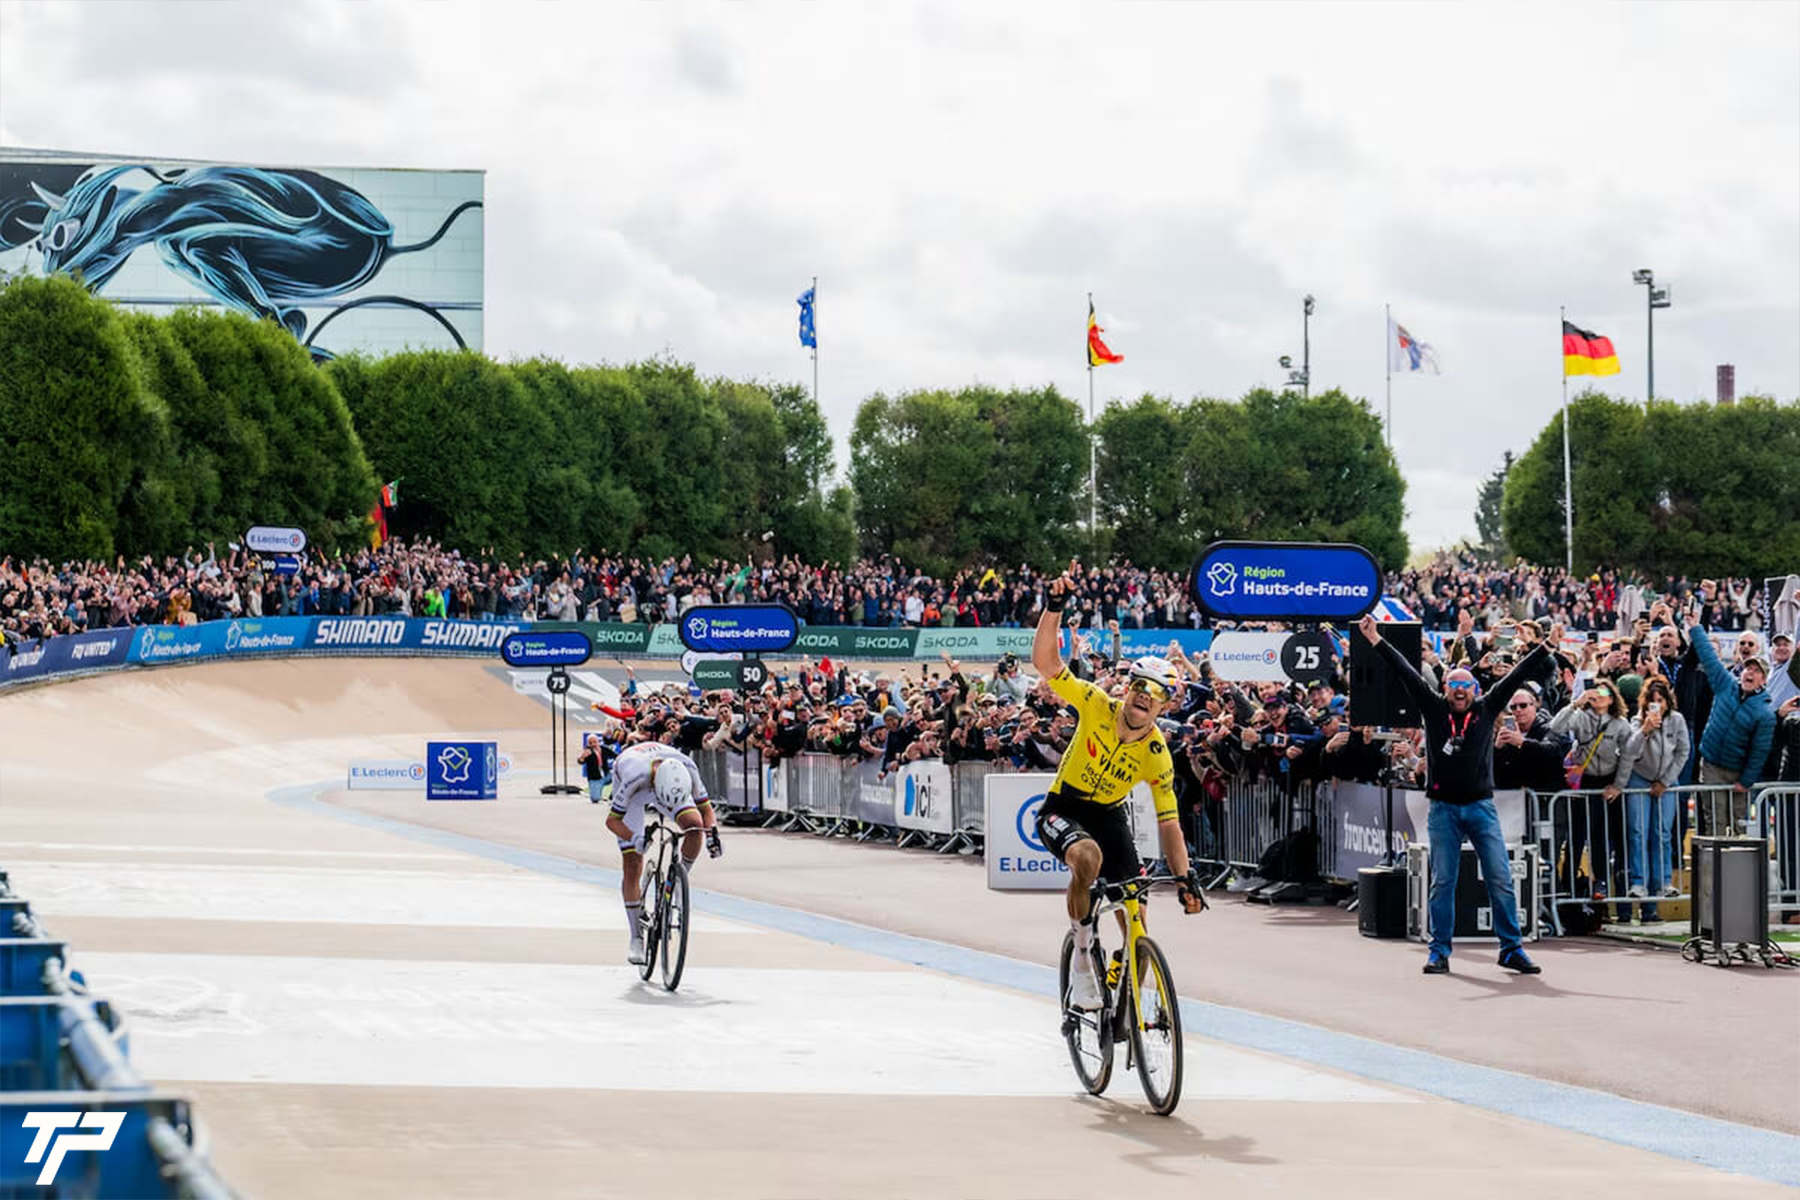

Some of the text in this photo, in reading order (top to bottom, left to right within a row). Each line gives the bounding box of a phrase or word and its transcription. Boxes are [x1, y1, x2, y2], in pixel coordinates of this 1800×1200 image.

[1243, 566, 1285, 579] Région
[1243, 582, 1369, 597] Hauts-de-France
[711, 620, 738, 628] Région
[314, 620, 405, 644] SHIMANO
[711, 628, 790, 639] Hauts-de-France
[525, 648, 586, 656] Hauts-de-France
[1294, 645, 1320, 670] 25
[743, 667, 761, 682] 50
[552, 678, 566, 689] 75
[352, 767, 407, 777] E.Leclerc
[915, 774, 931, 818] ici
